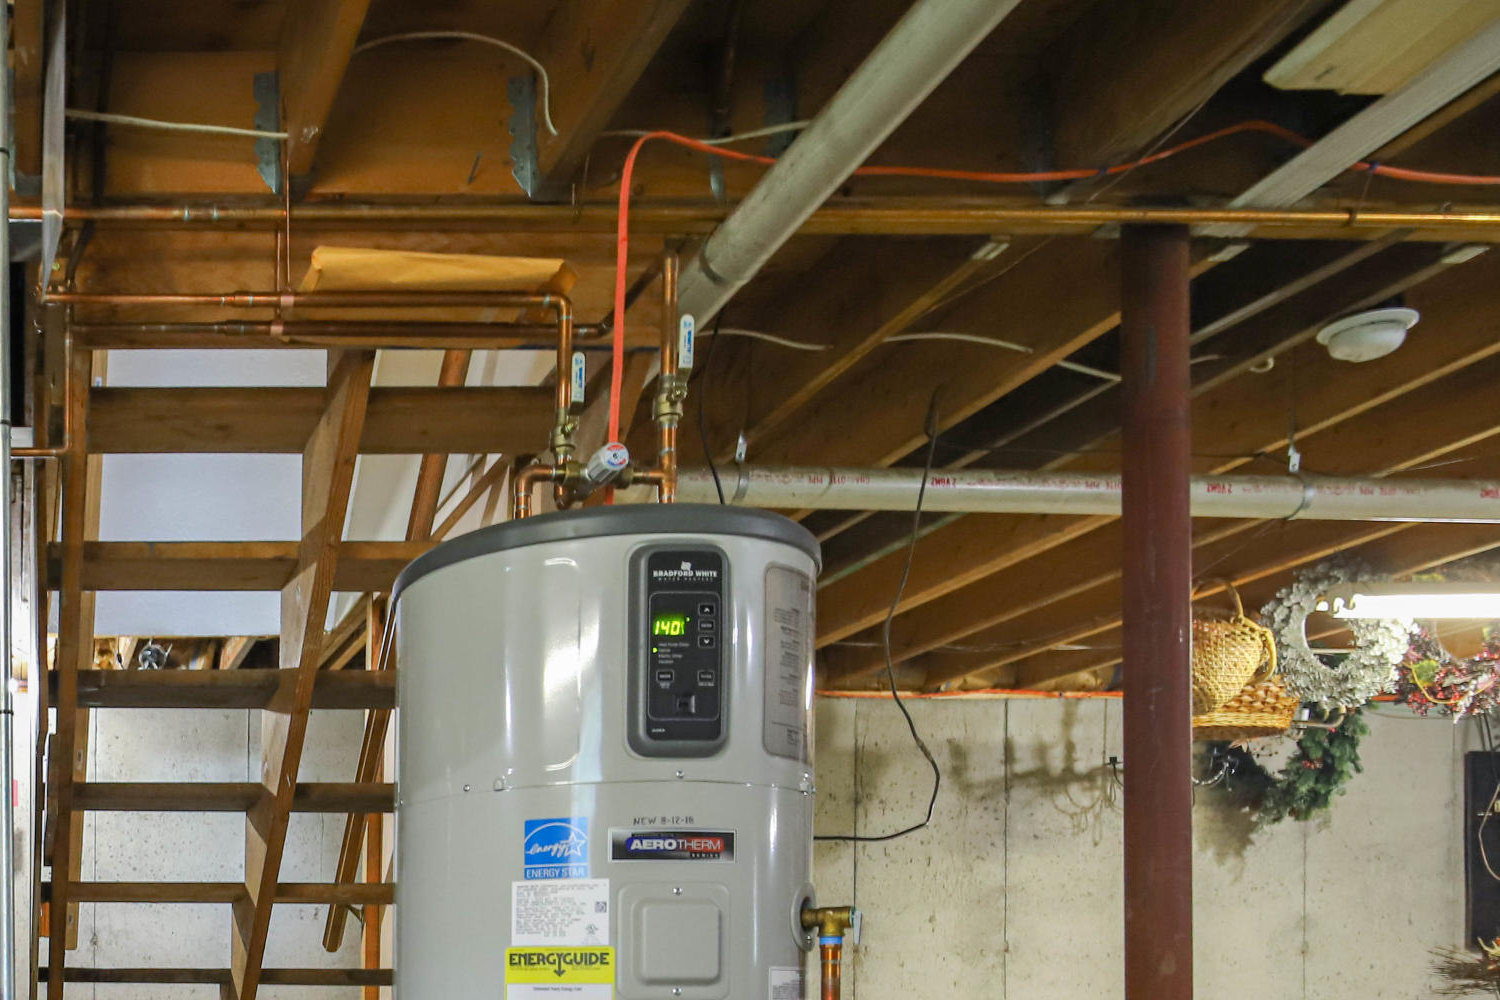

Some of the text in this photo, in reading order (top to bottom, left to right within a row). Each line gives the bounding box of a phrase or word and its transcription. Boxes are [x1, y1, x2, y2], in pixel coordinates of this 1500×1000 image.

[654, 620, 681, 635] 140
[633, 816, 657, 825] NEW
[630, 839, 721, 850] AEROTHERM
[526, 867, 585, 879] ENERGY STAR
[509, 952, 610, 967] ENERGYGUIDE
